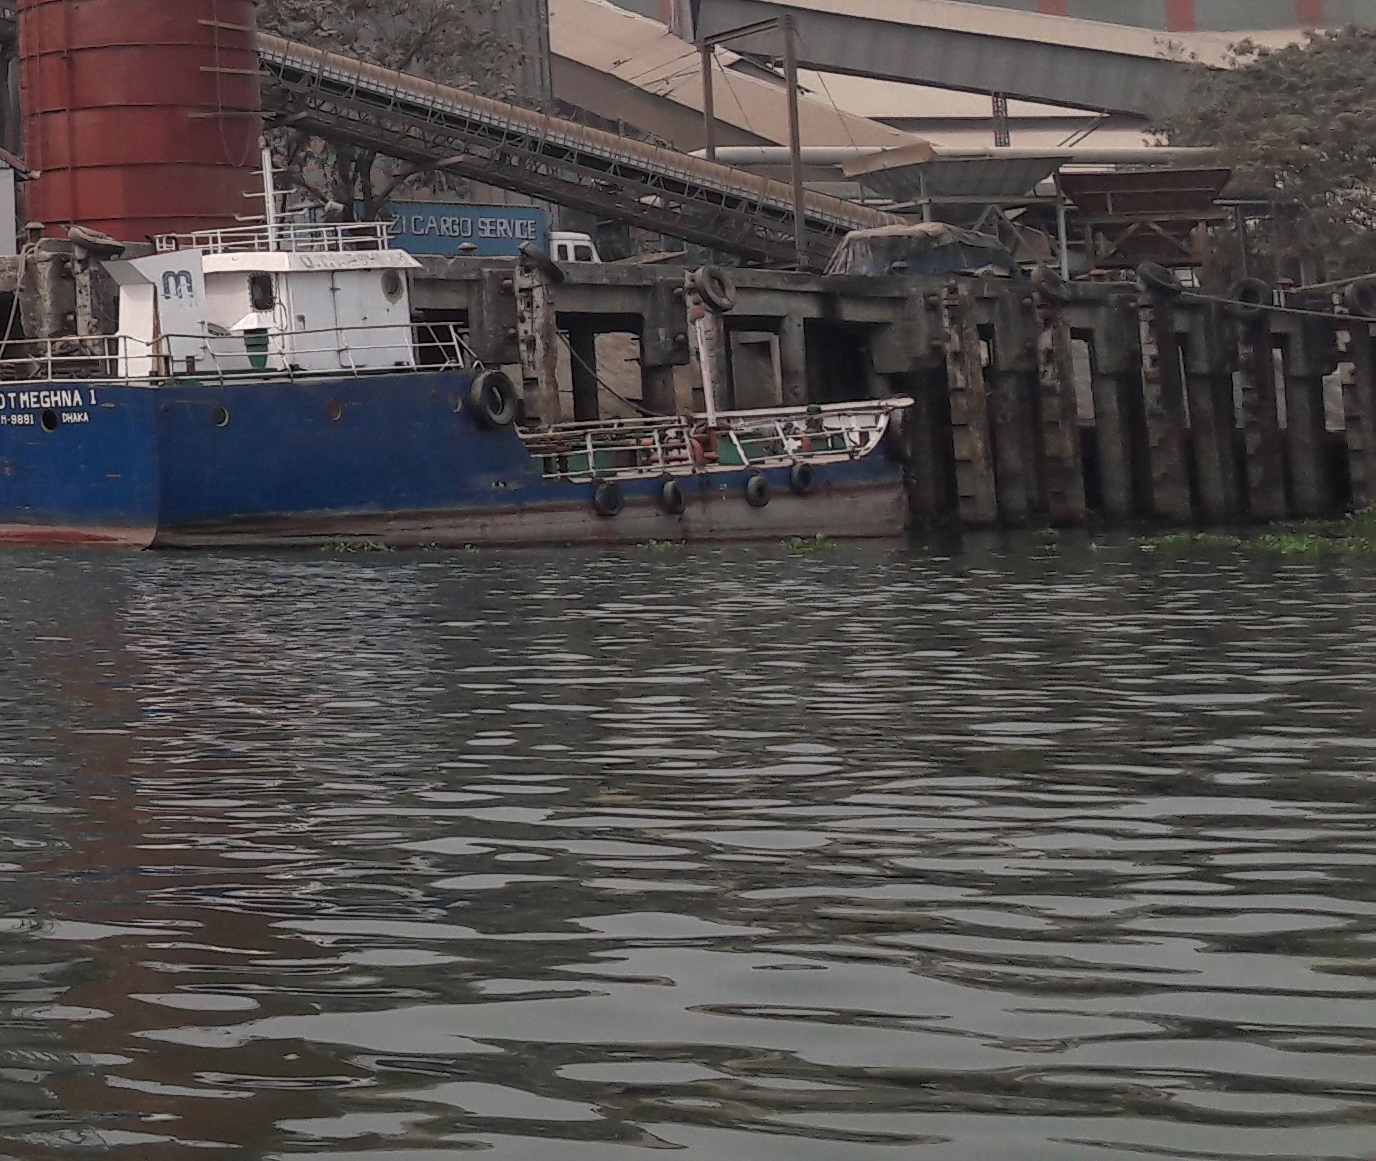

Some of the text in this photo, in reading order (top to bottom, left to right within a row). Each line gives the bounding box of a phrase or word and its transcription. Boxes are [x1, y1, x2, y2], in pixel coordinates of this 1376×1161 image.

[411, 215, 473, 237] CARGO
[478, 217, 537, 239] SERVICE
[19, 389, 83, 409] MEGHNA
[89, 388, 97, 405] 1
[61, 412, 89, 423] DHAKA
